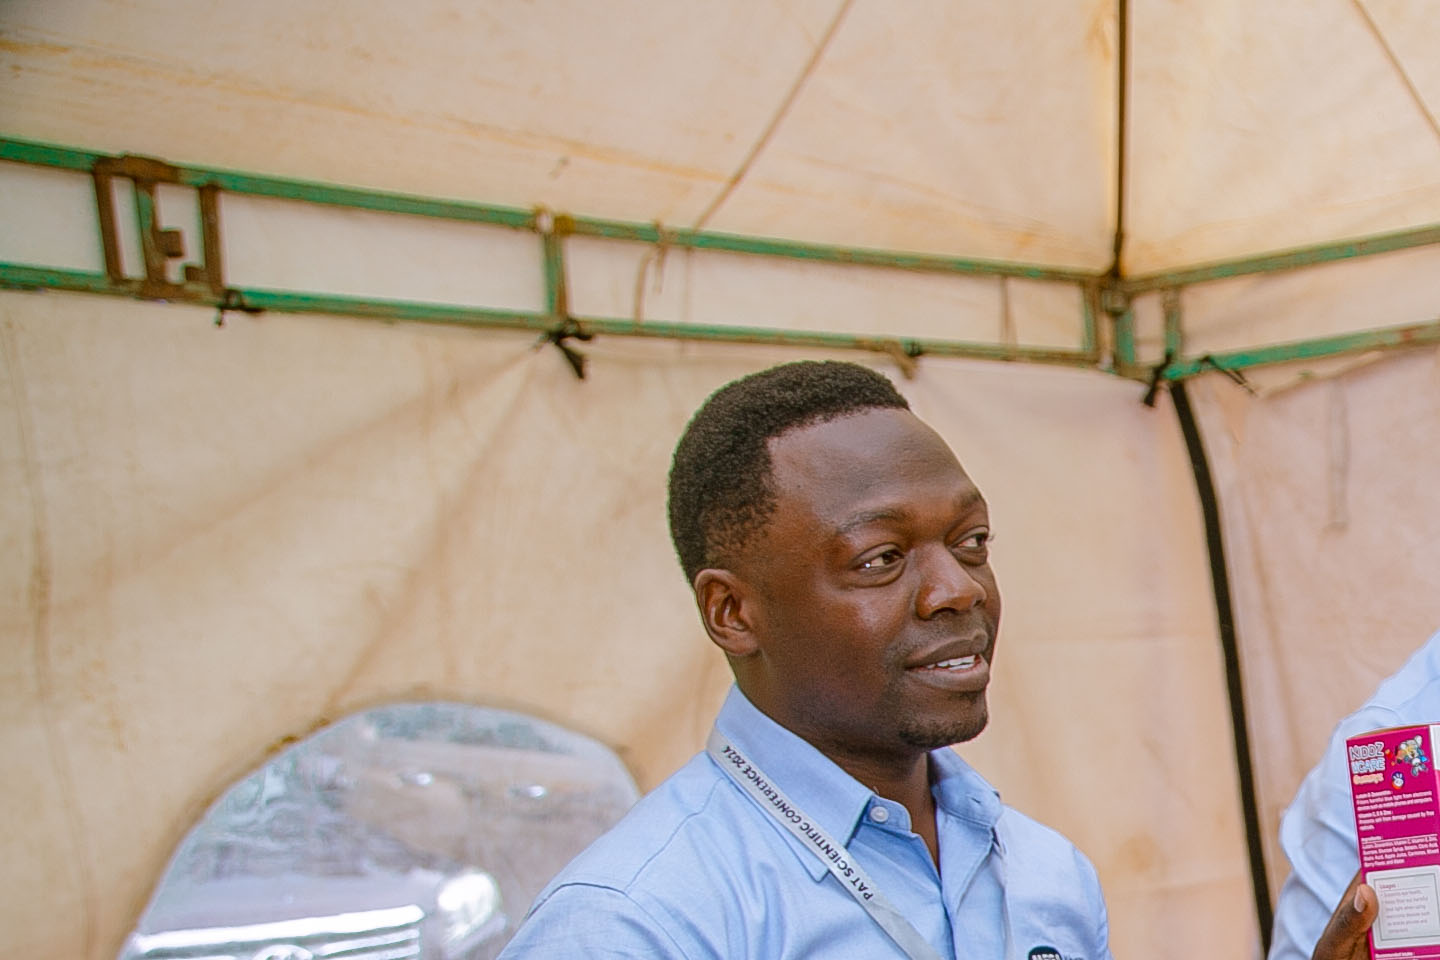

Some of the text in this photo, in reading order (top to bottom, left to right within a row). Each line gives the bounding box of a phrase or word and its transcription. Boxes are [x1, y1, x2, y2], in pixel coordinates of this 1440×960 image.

[1348, 742, 1384, 760] KIDDZ
[742, 766, 801, 823] CONFERENCE
[800, 822, 854, 877] SCIENTIFIC
[850, 877, 873, 900] PAT
